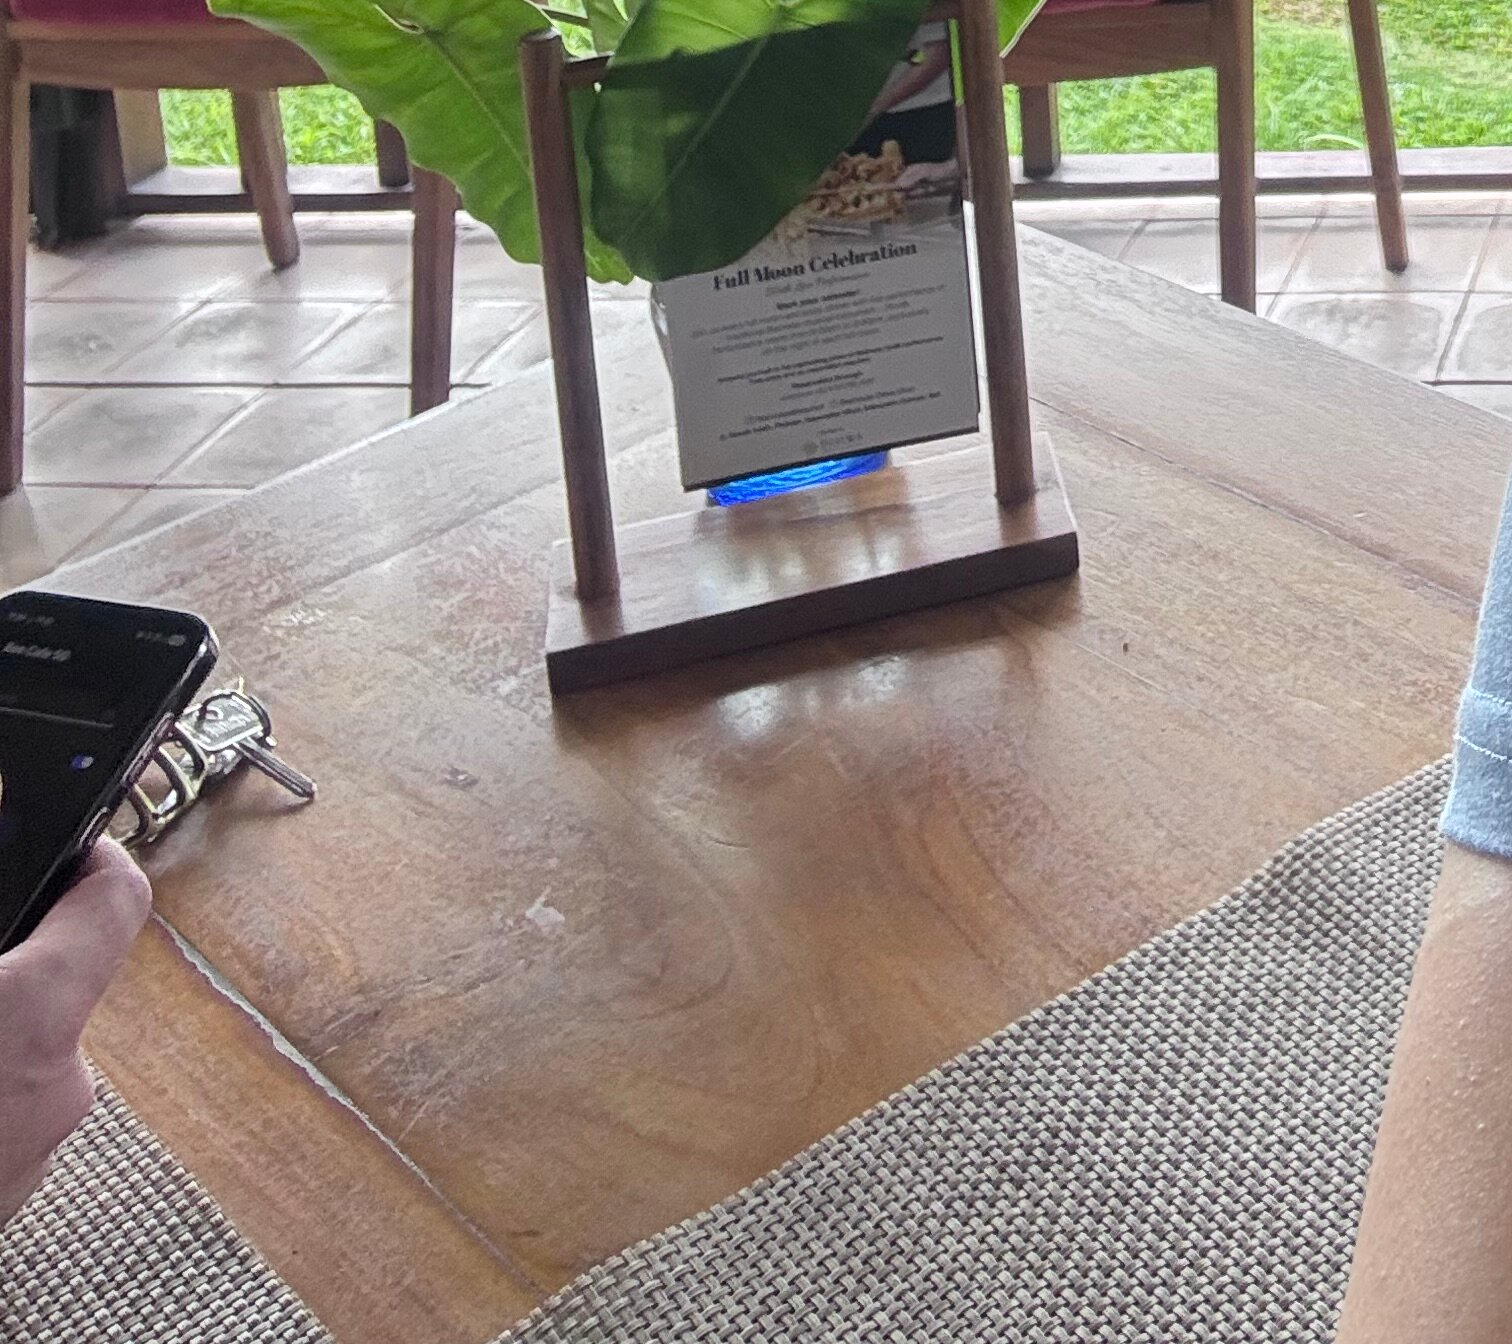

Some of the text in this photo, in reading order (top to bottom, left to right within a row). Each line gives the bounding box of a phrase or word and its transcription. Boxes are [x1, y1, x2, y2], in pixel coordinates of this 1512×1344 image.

[712, 268, 751, 291] Full
[754, 263, 805, 283] Moon
[808, 243, 918, 273] Celebration
